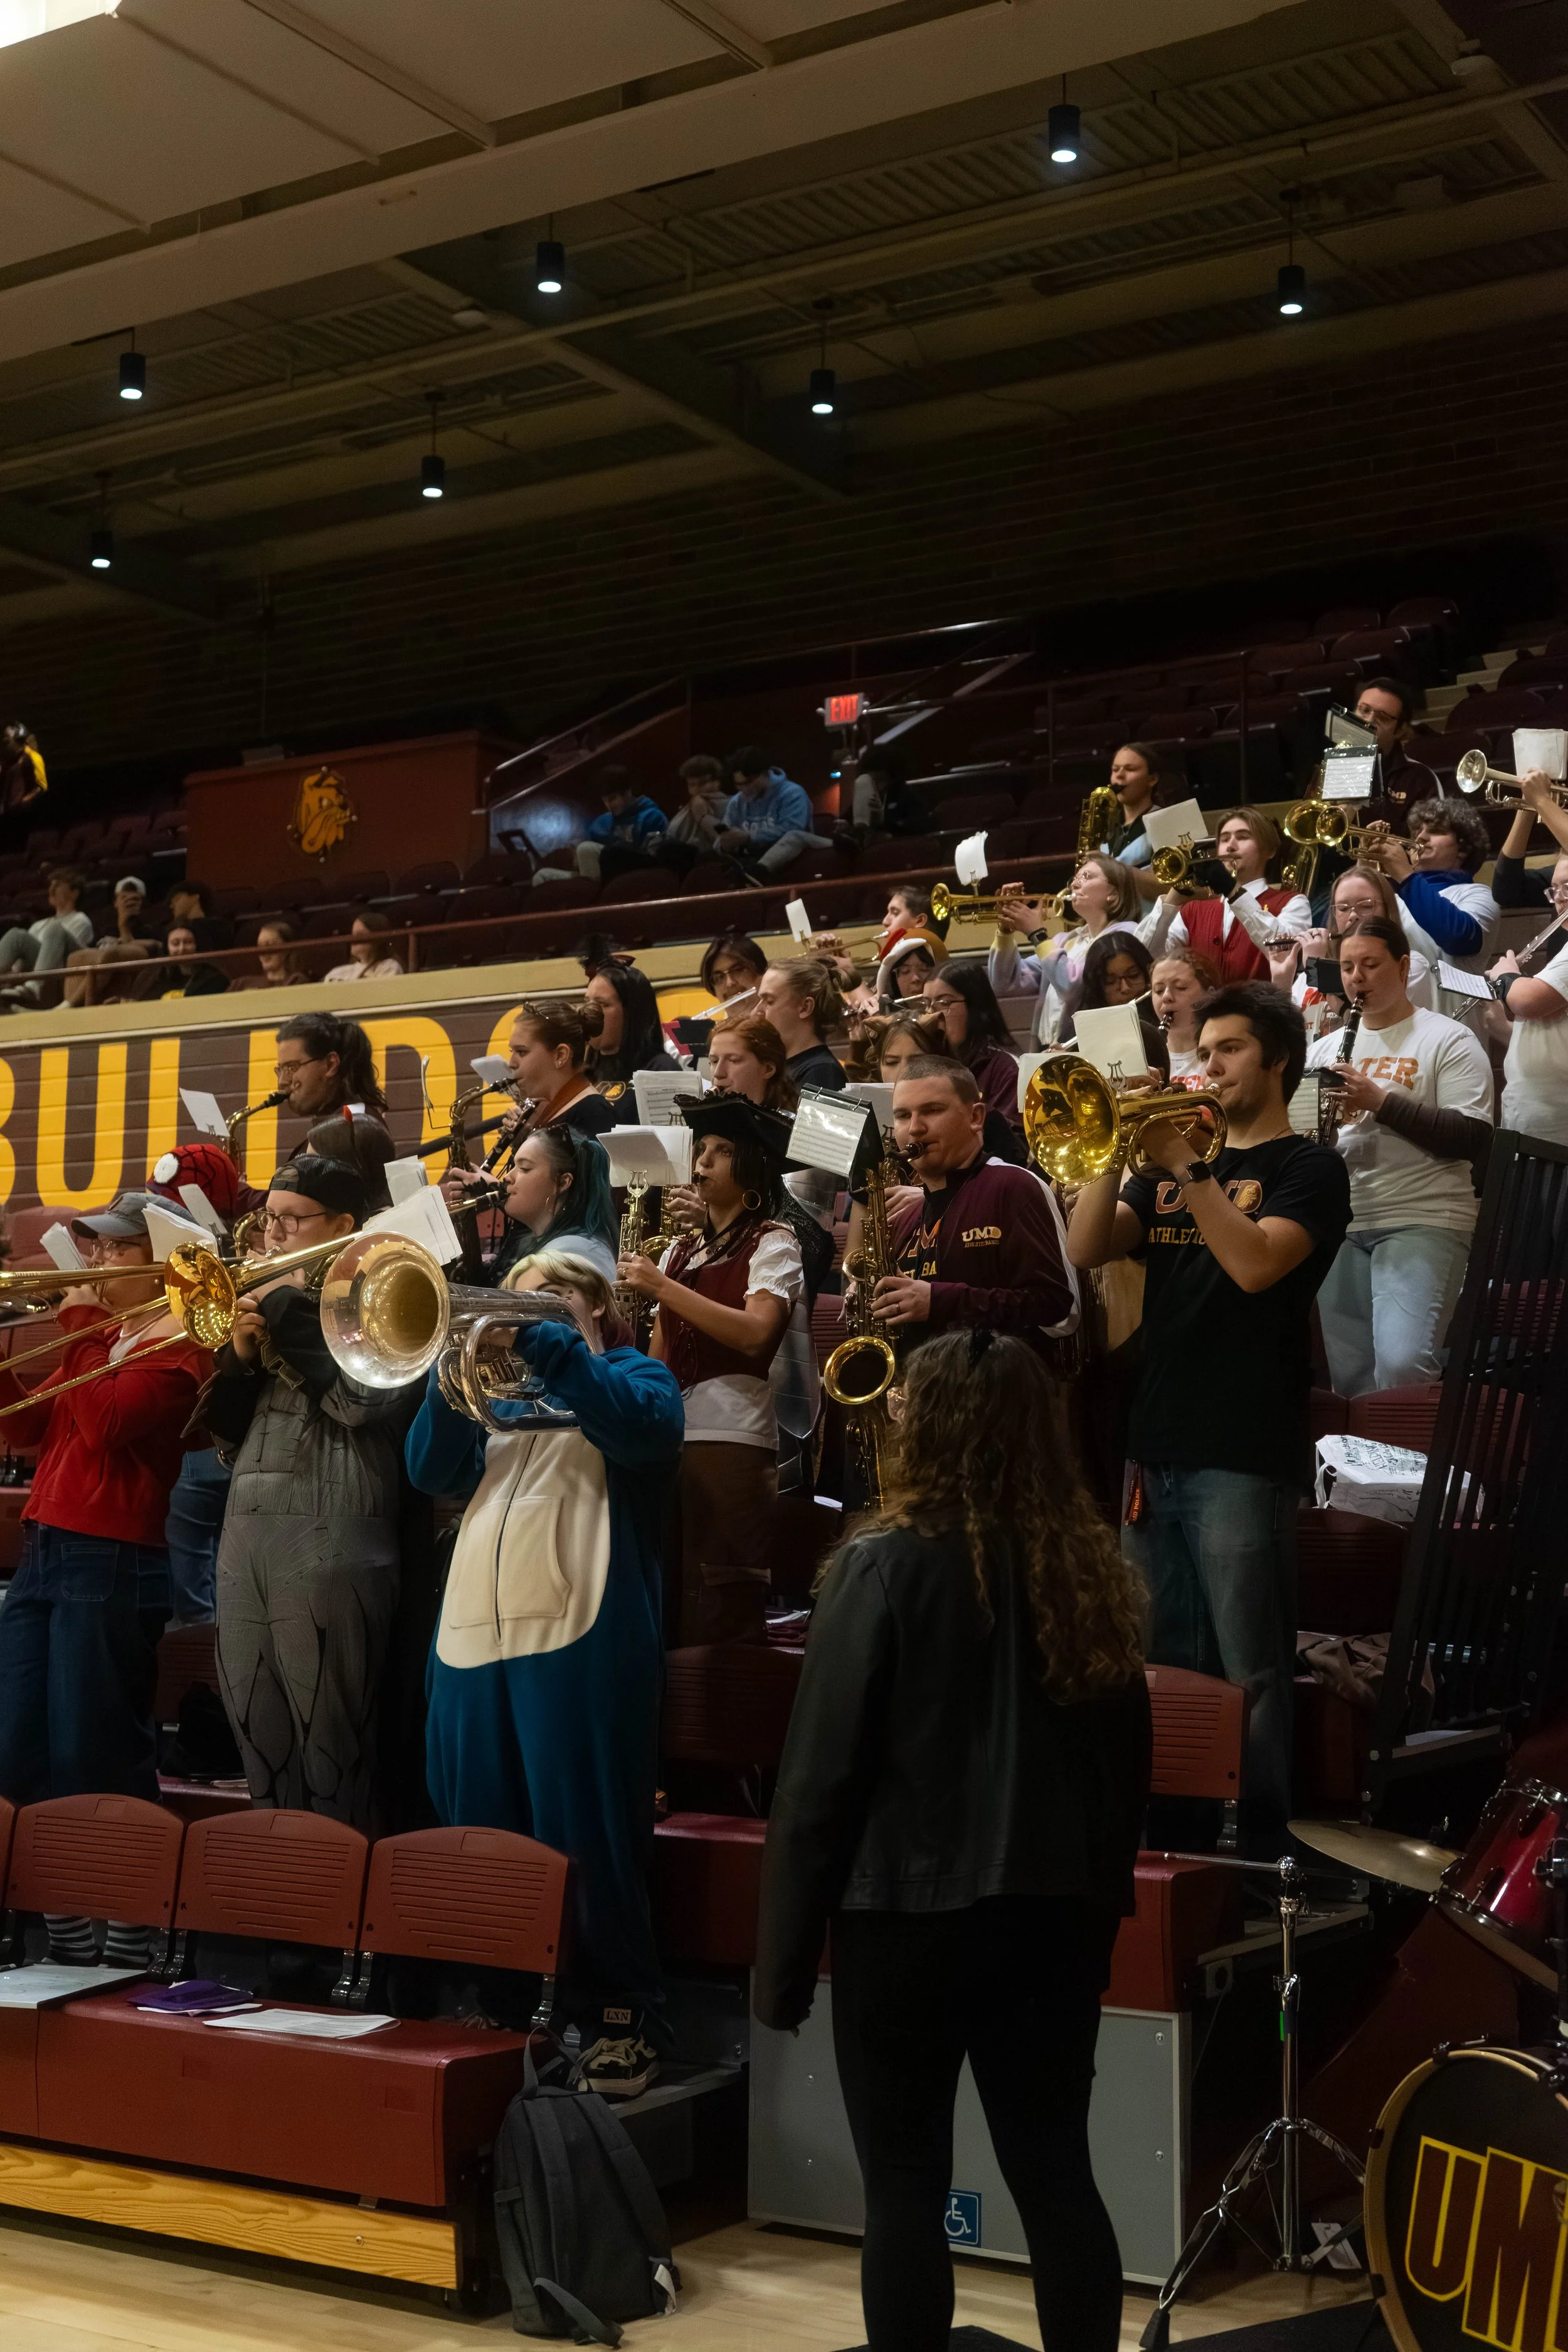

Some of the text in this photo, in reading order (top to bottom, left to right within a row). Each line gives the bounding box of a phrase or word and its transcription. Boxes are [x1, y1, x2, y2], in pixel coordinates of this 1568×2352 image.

[830, 694, 859, 723] EXIT
[1357, 1056, 1419, 1091] TER
[1155, 1179, 1263, 1214] UD
[961, 1226, 1002, 1242] UMD
[606, 2010, 629, 2021] LXN
[1405, 2134, 1568, 2352] UM
